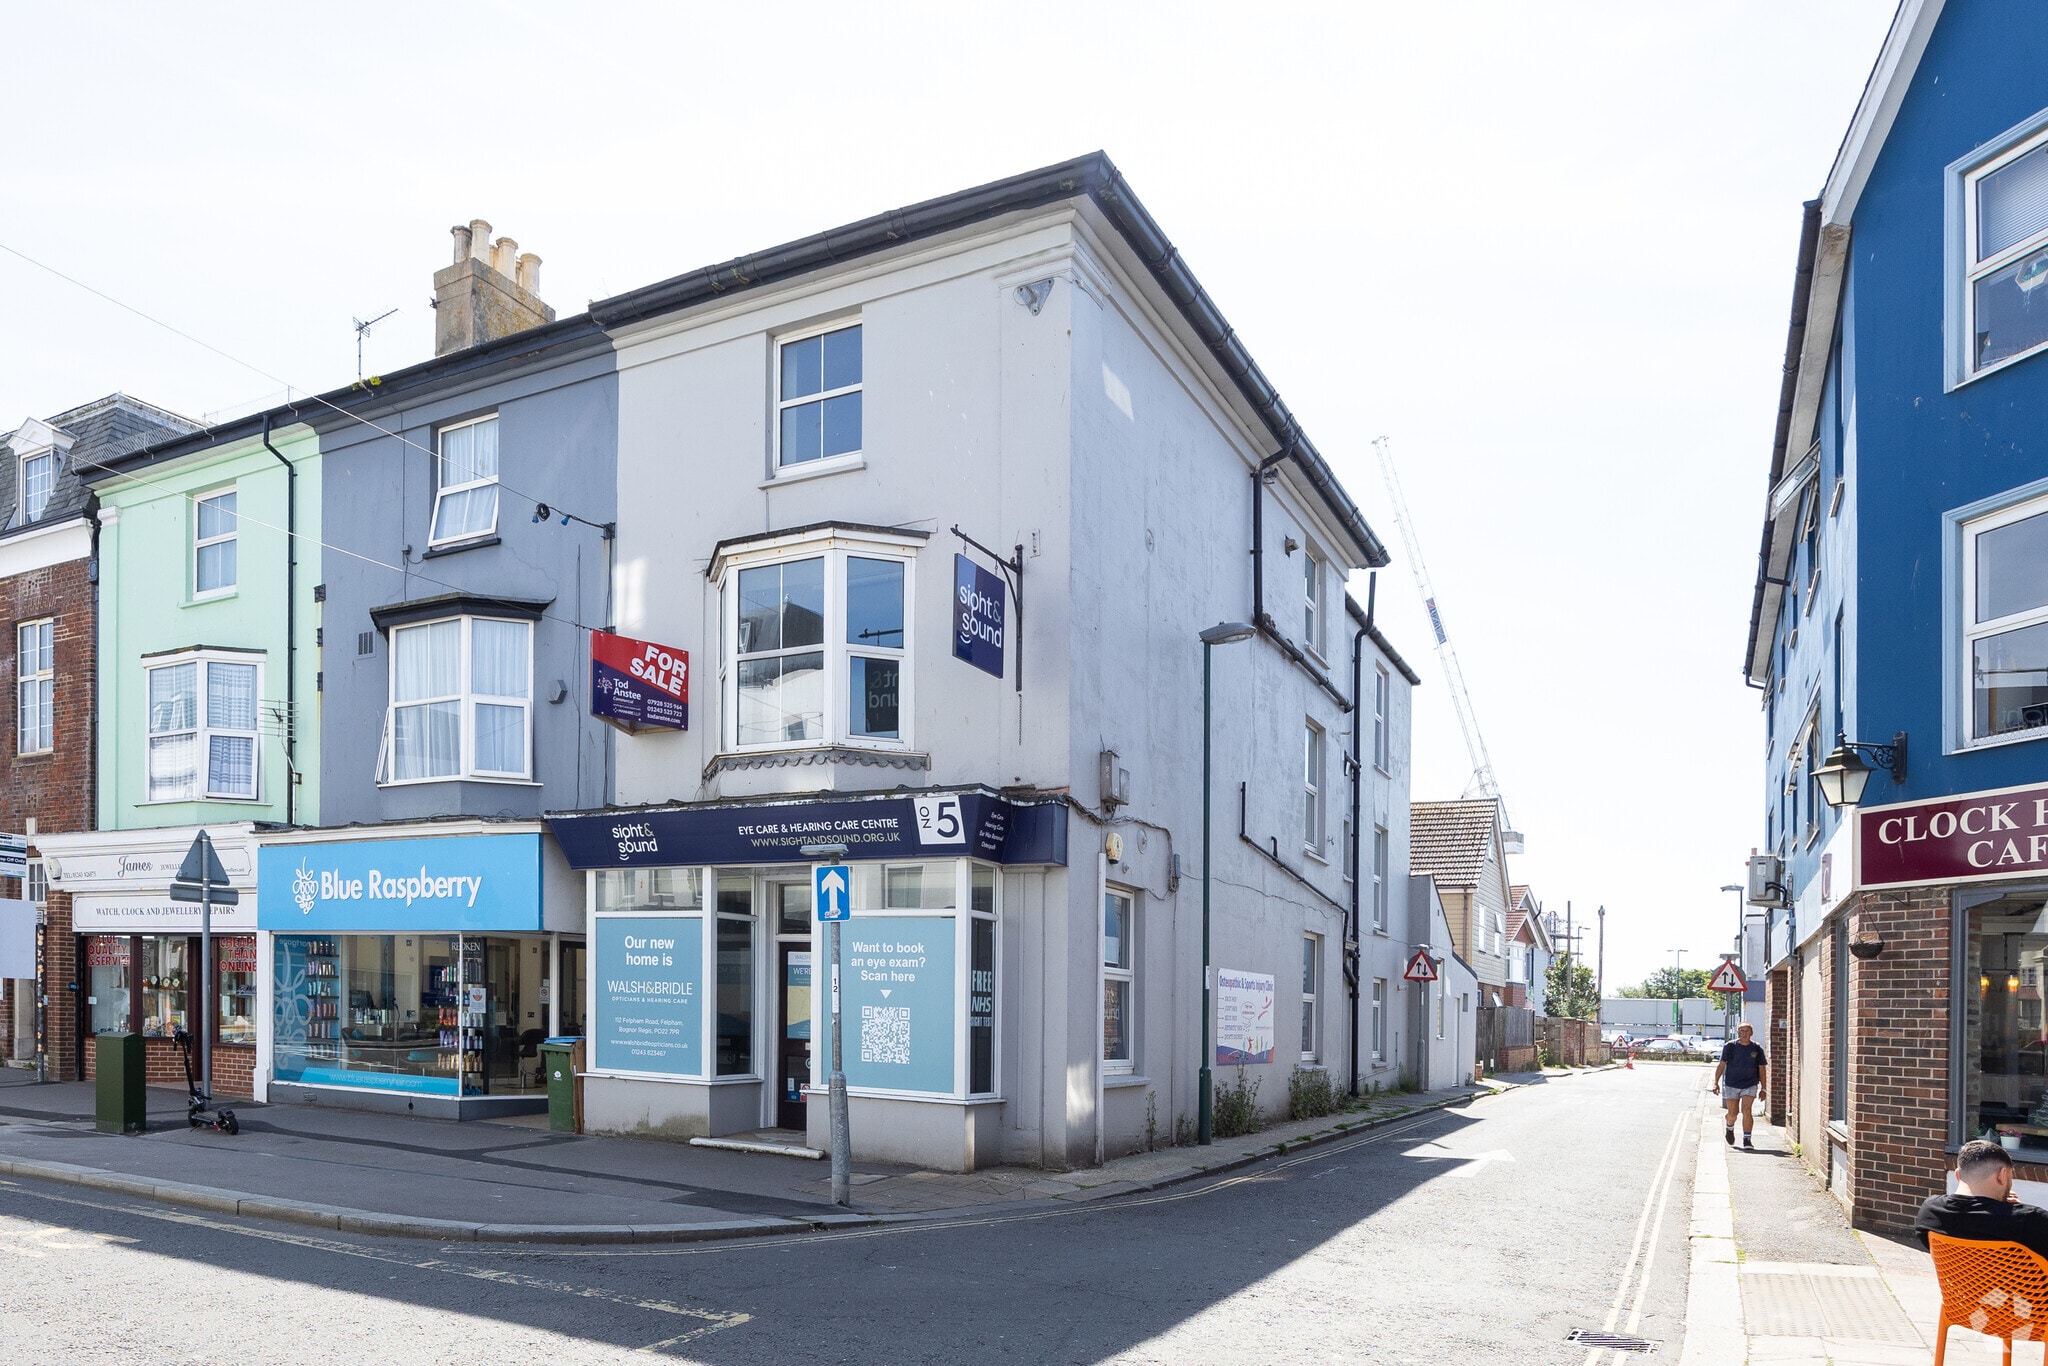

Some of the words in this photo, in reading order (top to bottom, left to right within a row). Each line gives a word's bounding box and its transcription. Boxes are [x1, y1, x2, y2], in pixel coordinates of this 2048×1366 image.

[962, 612, 1002, 648] sound
[645, 644, 686, 680] FOR
[613, 678, 629, 689] Tod
[629, 657, 684, 697] SALE
[613, 687, 642, 700] Anstee
[647, 706, 663, 714] 01243
[738, 826, 753, 835] EYE
[756, 824, 779, 834] CARE
[781, 823, 788, 833] &
[790, 821, 831, 833] HEARING
[834, 820, 859, 831] CARE
[861, 818, 899, 829] CENTRE
[937, 801, 960, 838] 5
[1878, 802, 2020, 845] CLOCK
[618, 837, 658, 853] sound
[751, 832, 900, 847] WWW.SIGHTANDSOUND.ORG.UK
[1967, 834, 2048, 868] CAF
[117, 855, 153, 877] James
[321, 868, 363, 900] Blue
[368, 864, 482, 908] Raspberry
[96, 908, 121, 916] WATCH,
[121, 907, 145, 916] CLOCK
[146, 907, 160, 916] AND
[161, 906, 201, 916] JEWELLERY
[209, 906, 235, 915] EPAIRS
[625, 935, 646, 949] Our
[650, 938, 674, 949] new
[852, 942, 880, 953] Want
[882, 942, 894, 953] to
[896, 942, 925, 953] book
[88, 945, 127, 955] QUALITY
[228, 948, 256, 960] THAN
[220, 960, 256, 972] ONLINE
[626, 952, 659, 966] home
[662, 952, 673, 966] is
[851, 957, 864, 967] an
[867, 957, 886, 969] eye
[889, 956, 926, 968] exam?
[860, 970, 887, 981] Scan
[891, 970, 915, 982] here
[971, 970, 992, 993] FREE
[607, 979, 693, 996] WALSH&BRIDLE
[971, 996, 991, 1013] NHS
[622, 1017, 644, 1025] Felpham
[329, 1073, 423, 1088] www.blueraspberryhair.com
